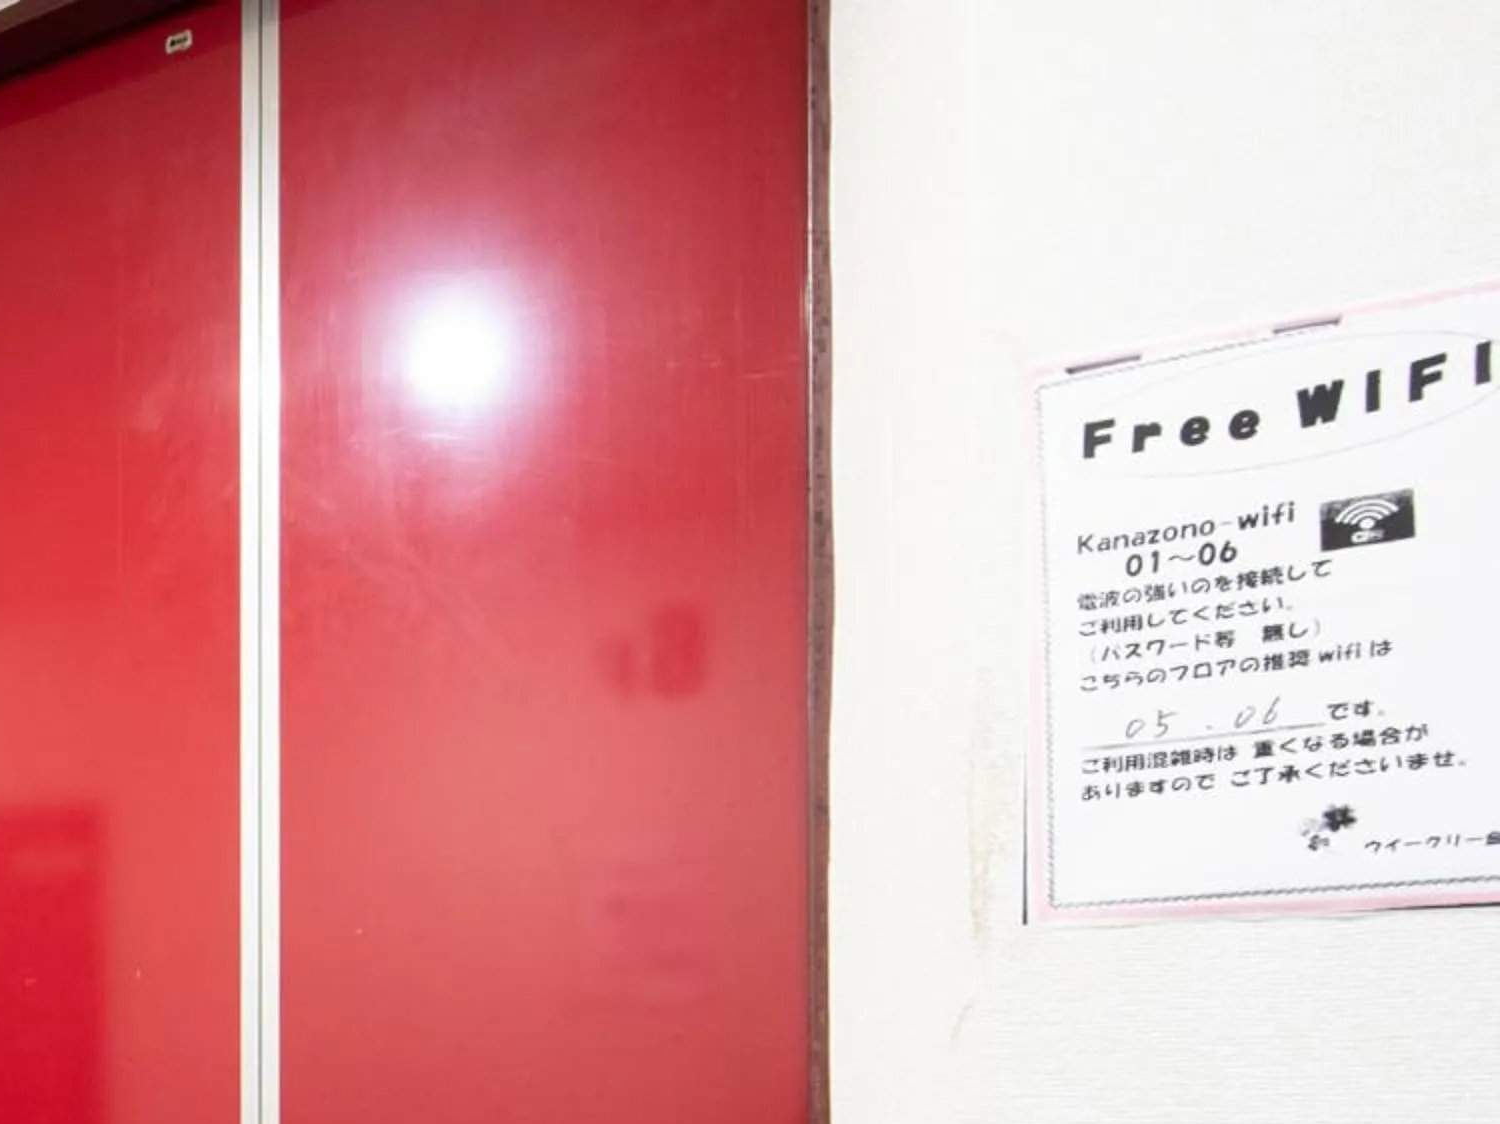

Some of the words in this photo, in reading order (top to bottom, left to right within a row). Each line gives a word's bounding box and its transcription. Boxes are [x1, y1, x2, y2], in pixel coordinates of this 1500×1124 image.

[1083, 409, 1261, 459] Free
[1297, 340, 1492, 428] WIFI
[1077, 559, 1333, 611] 電波の強いのを接続して
[1081, 773, 1216, 802] ありますので
